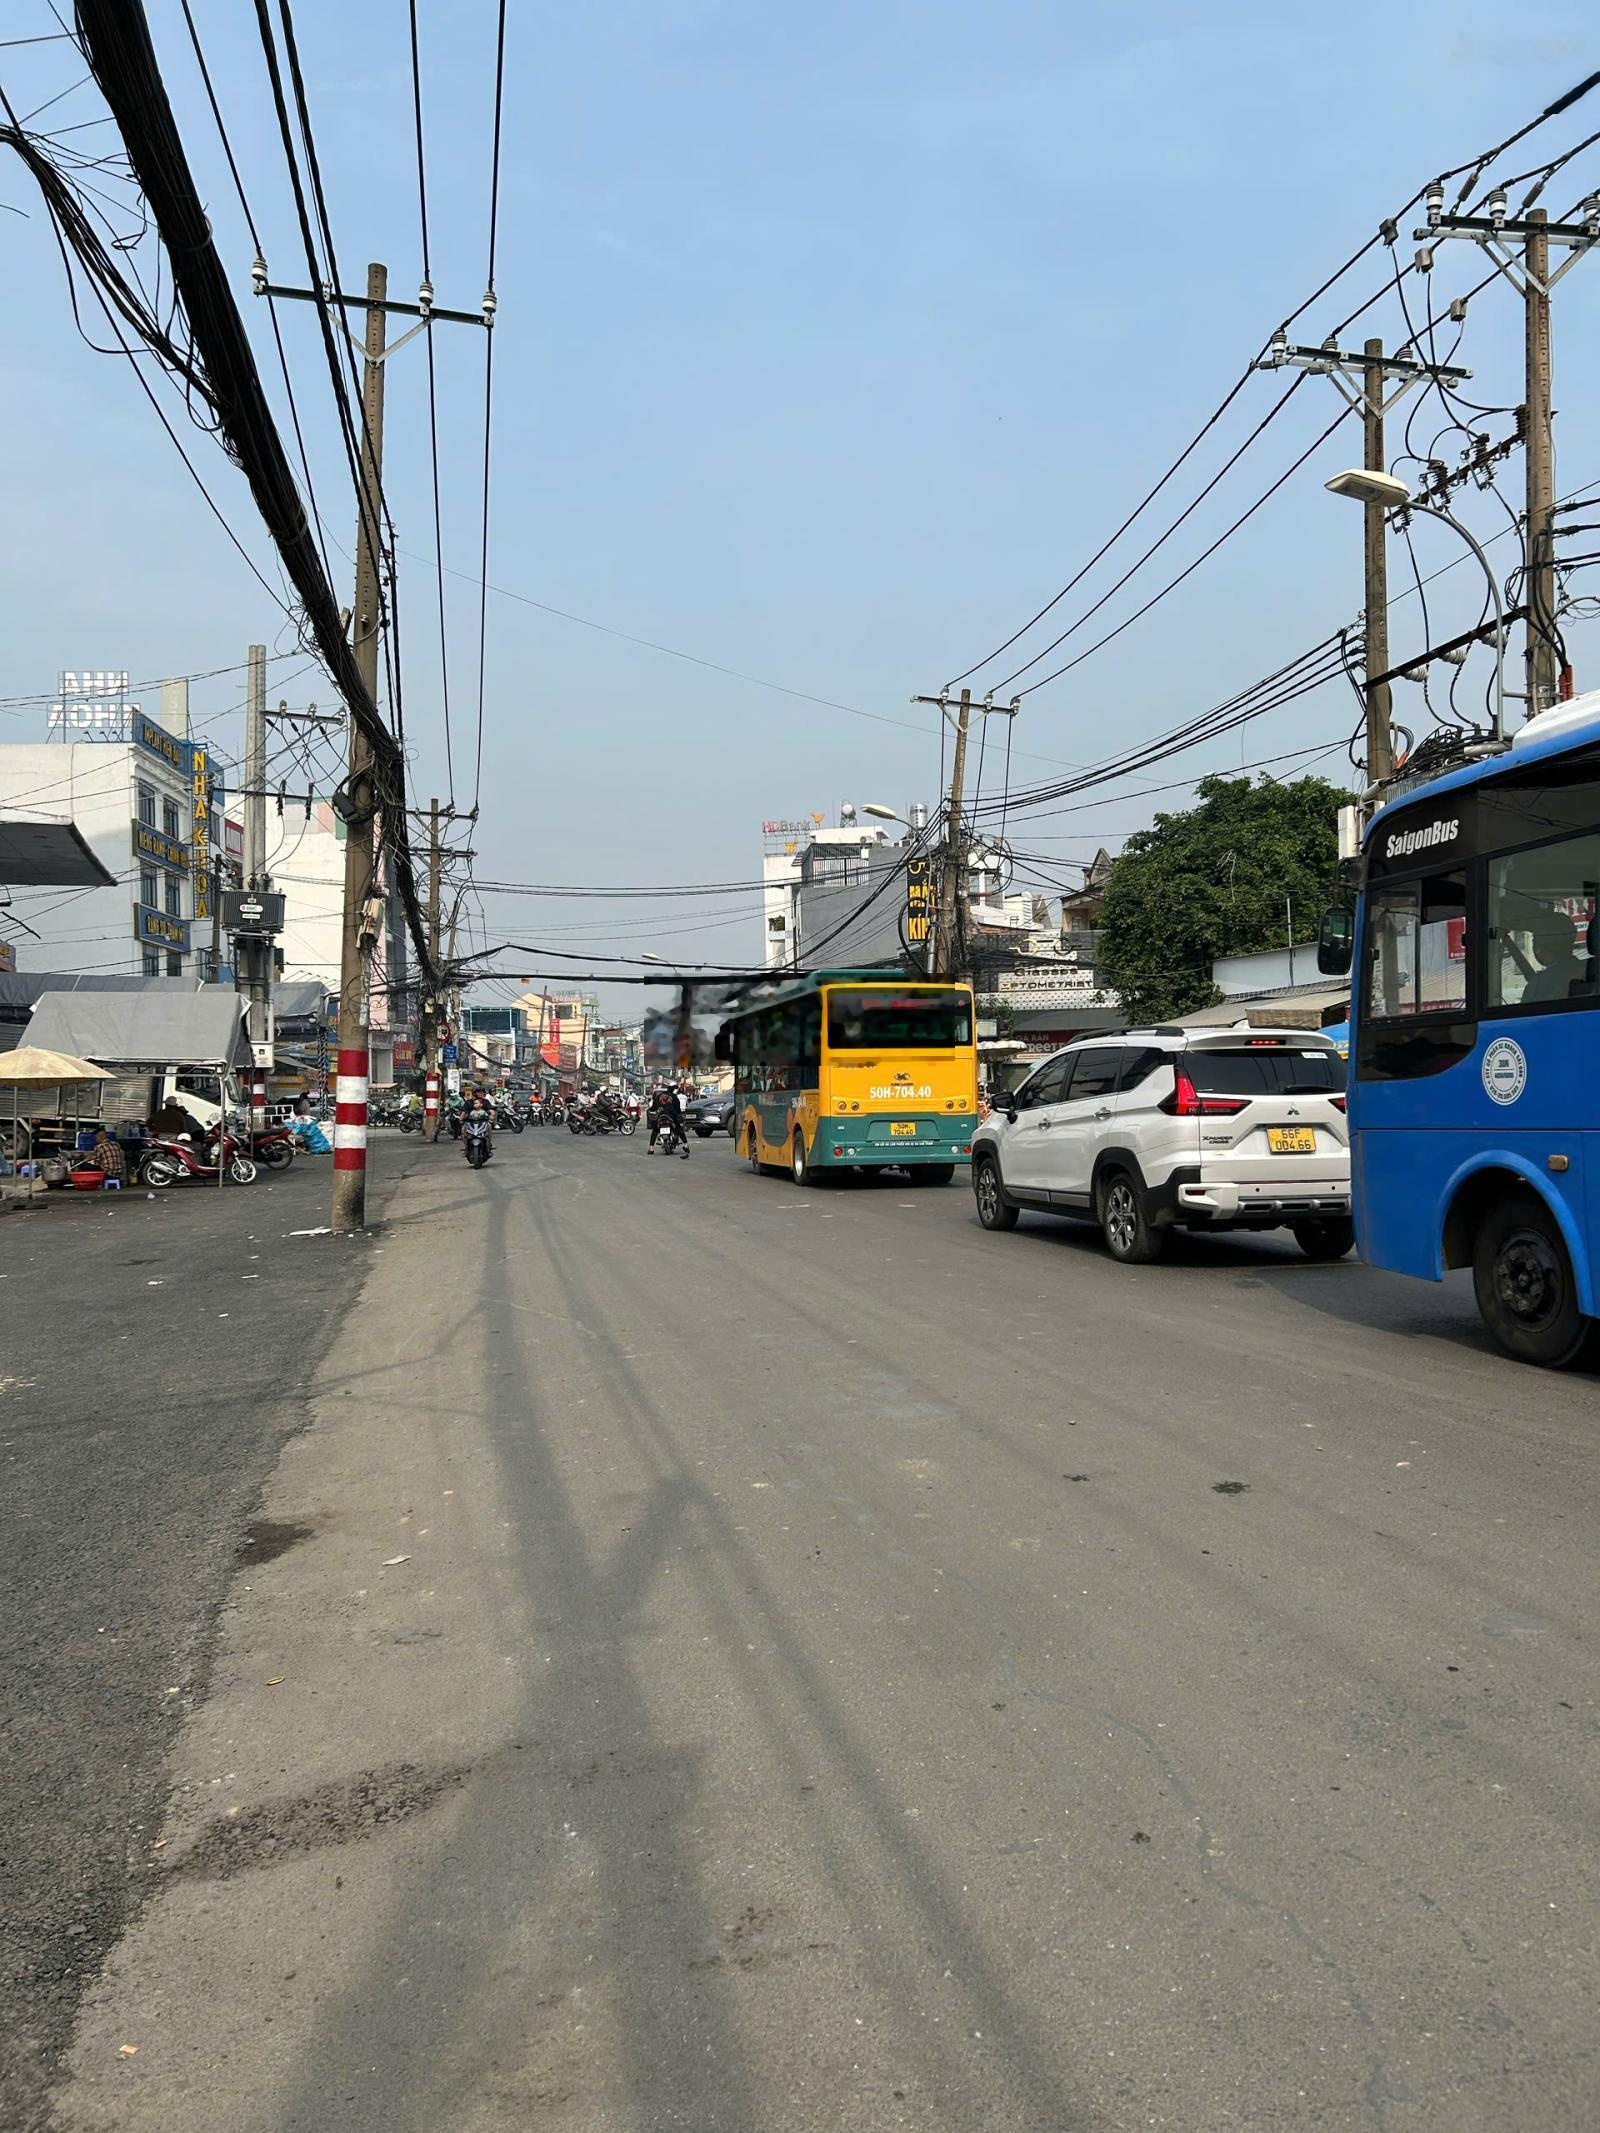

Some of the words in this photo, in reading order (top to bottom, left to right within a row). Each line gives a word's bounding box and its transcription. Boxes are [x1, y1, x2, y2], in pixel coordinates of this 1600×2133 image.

[762, 820, 811, 832] HDBank
[1386, 819, 1459, 858] SaigonBus
[909, 913, 931, 940] KÍN
[869, 1086, 932, 1099] 50H-704.40
[1281, 1128, 1300, 1139] 66F
[1275, 1139, 1311, 1151] 004.66
